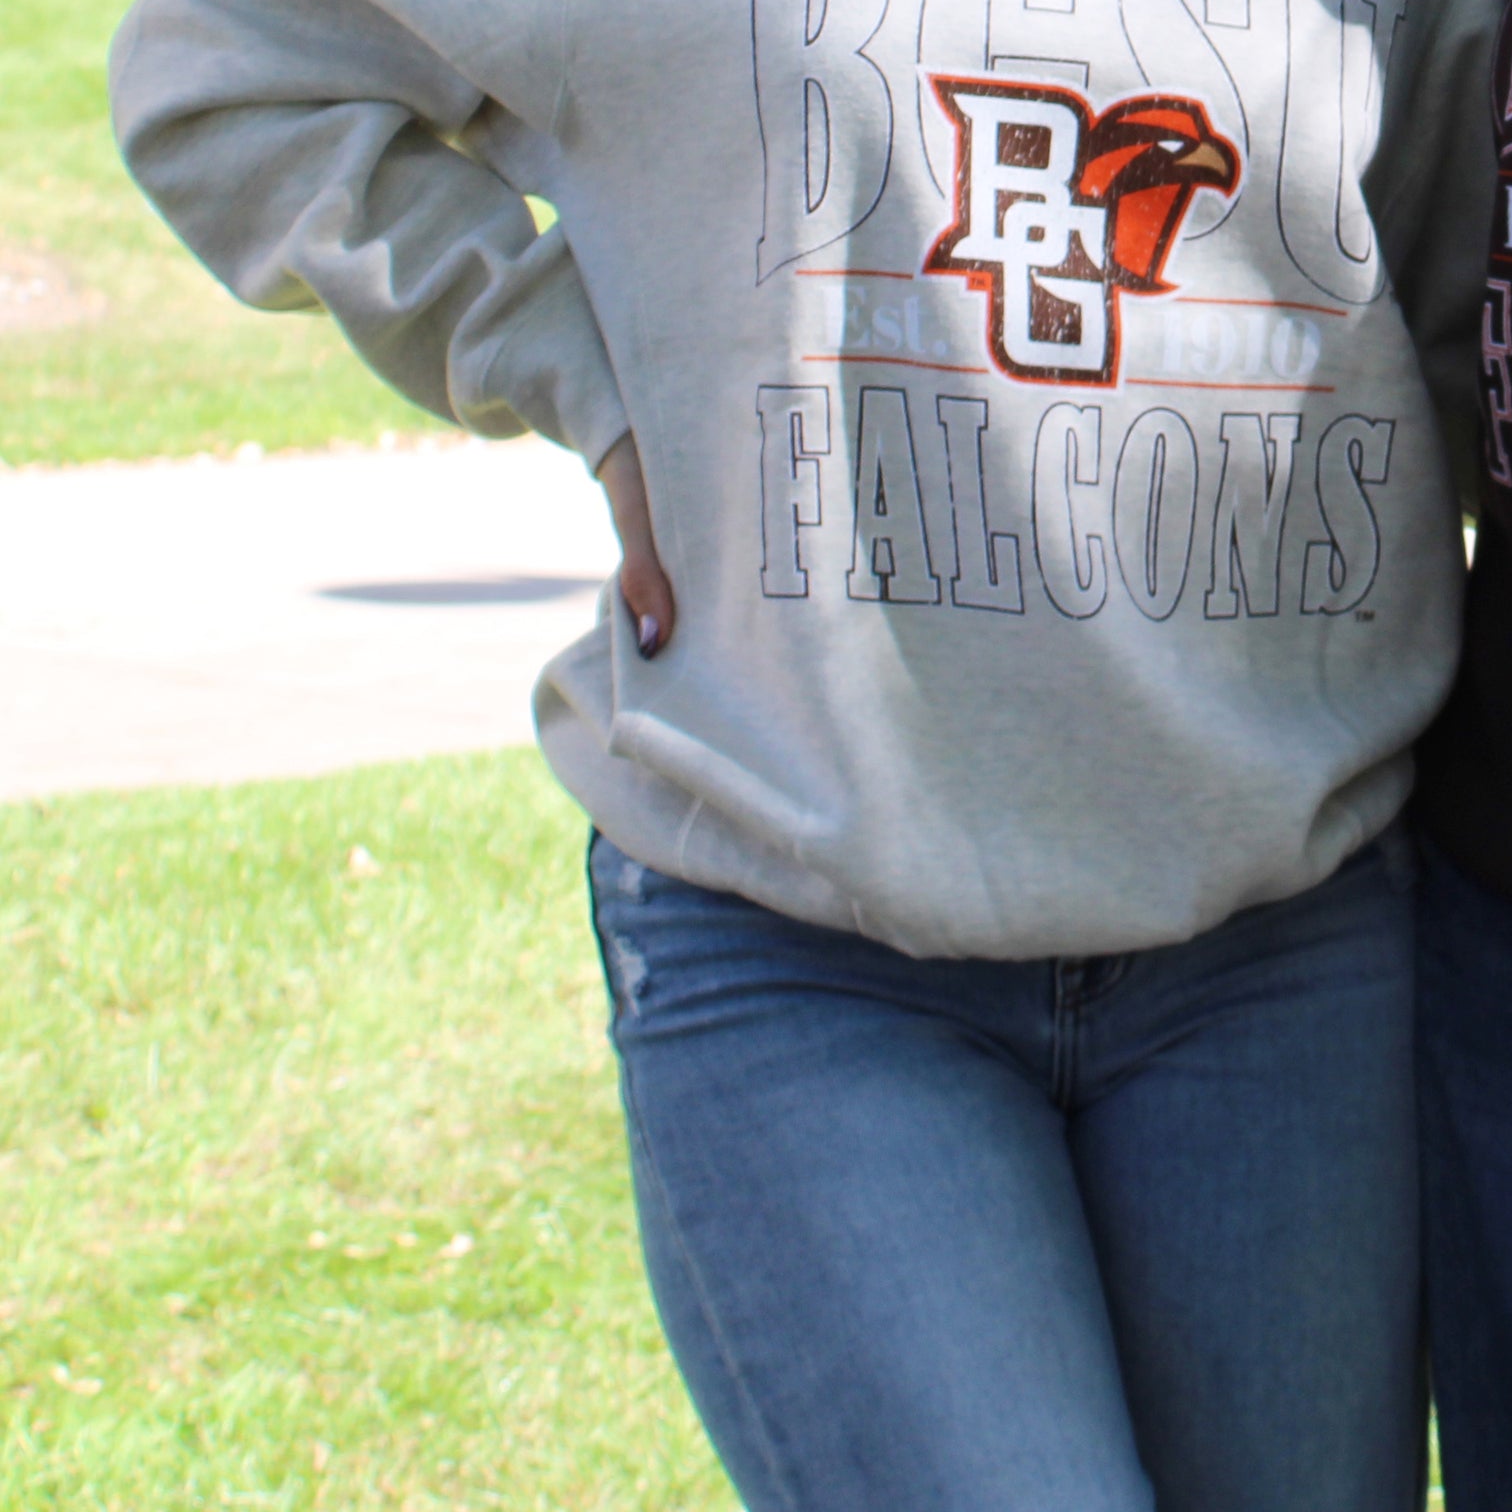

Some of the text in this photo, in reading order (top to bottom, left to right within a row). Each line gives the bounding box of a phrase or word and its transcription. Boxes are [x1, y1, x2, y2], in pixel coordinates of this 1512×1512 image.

[812, 286, 1322, 378] Est. 1910
[756, 385, 1396, 621] FALCONS
